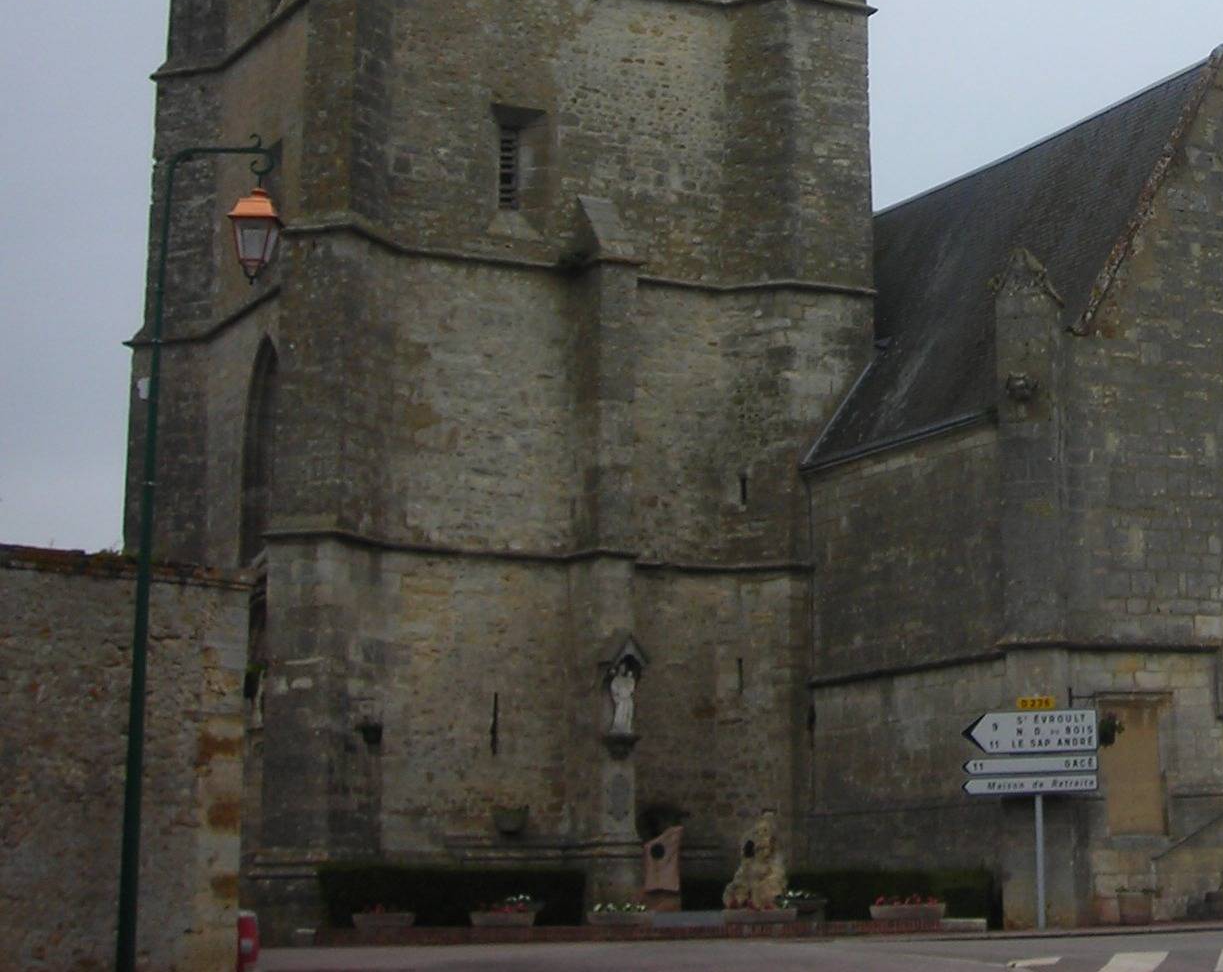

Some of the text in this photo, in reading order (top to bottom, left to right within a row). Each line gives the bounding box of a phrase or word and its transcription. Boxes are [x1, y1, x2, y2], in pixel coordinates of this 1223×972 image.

[1034, 713, 1086, 725] ÉVROULT
[1065, 725, 1094, 735] BOIS
[989, 739, 999, 749] 11
[1011, 735, 1094, 749] LE SAP ANDRÉ
[972, 762, 984, 771] 11
[1064, 759, 1094, 769] GACÉ
[987, 778, 1095, 791] Maison de Retraite
